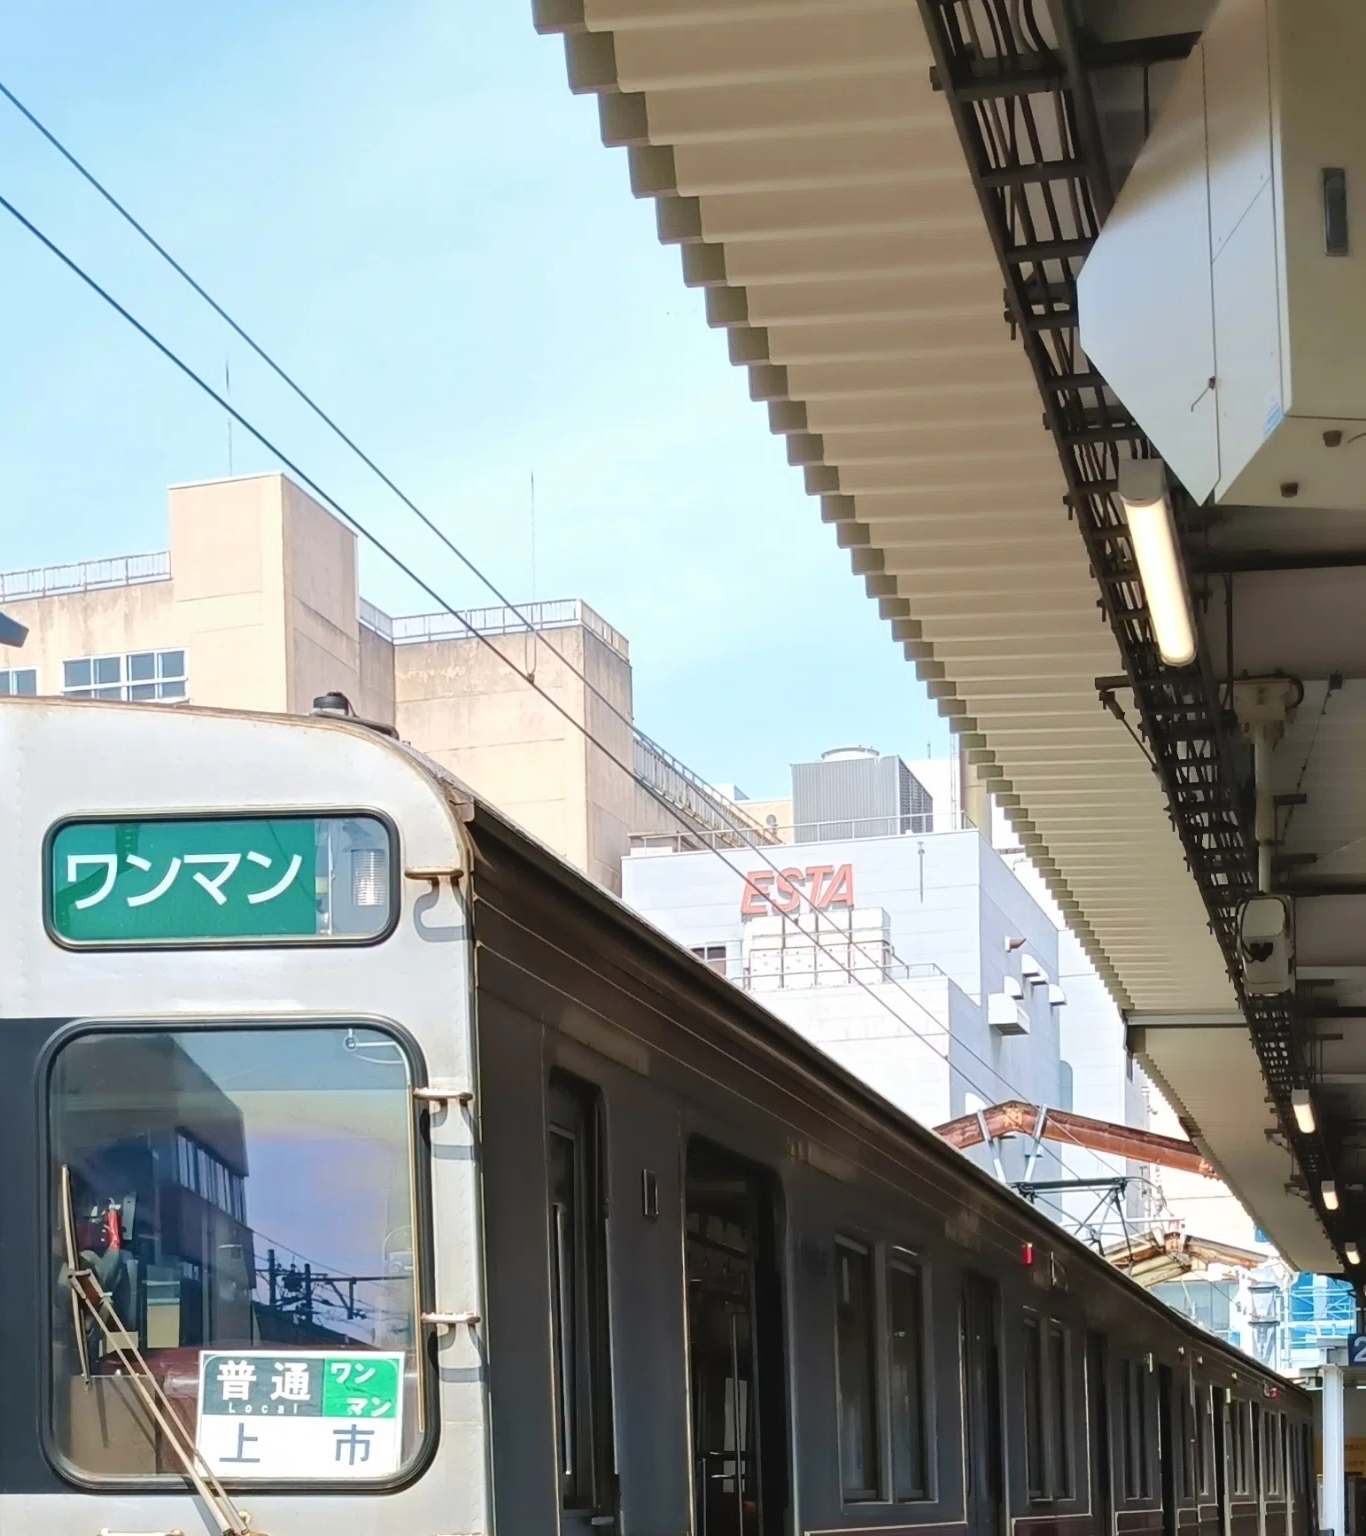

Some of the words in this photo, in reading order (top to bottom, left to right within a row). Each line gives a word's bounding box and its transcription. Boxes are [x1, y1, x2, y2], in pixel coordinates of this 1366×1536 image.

[66, 850, 303, 910] ワンマン
[739, 863, 855, 915] ESTA
[216, 1359, 311, 1402] 普通
[228, 1402, 299, 1415] Local
